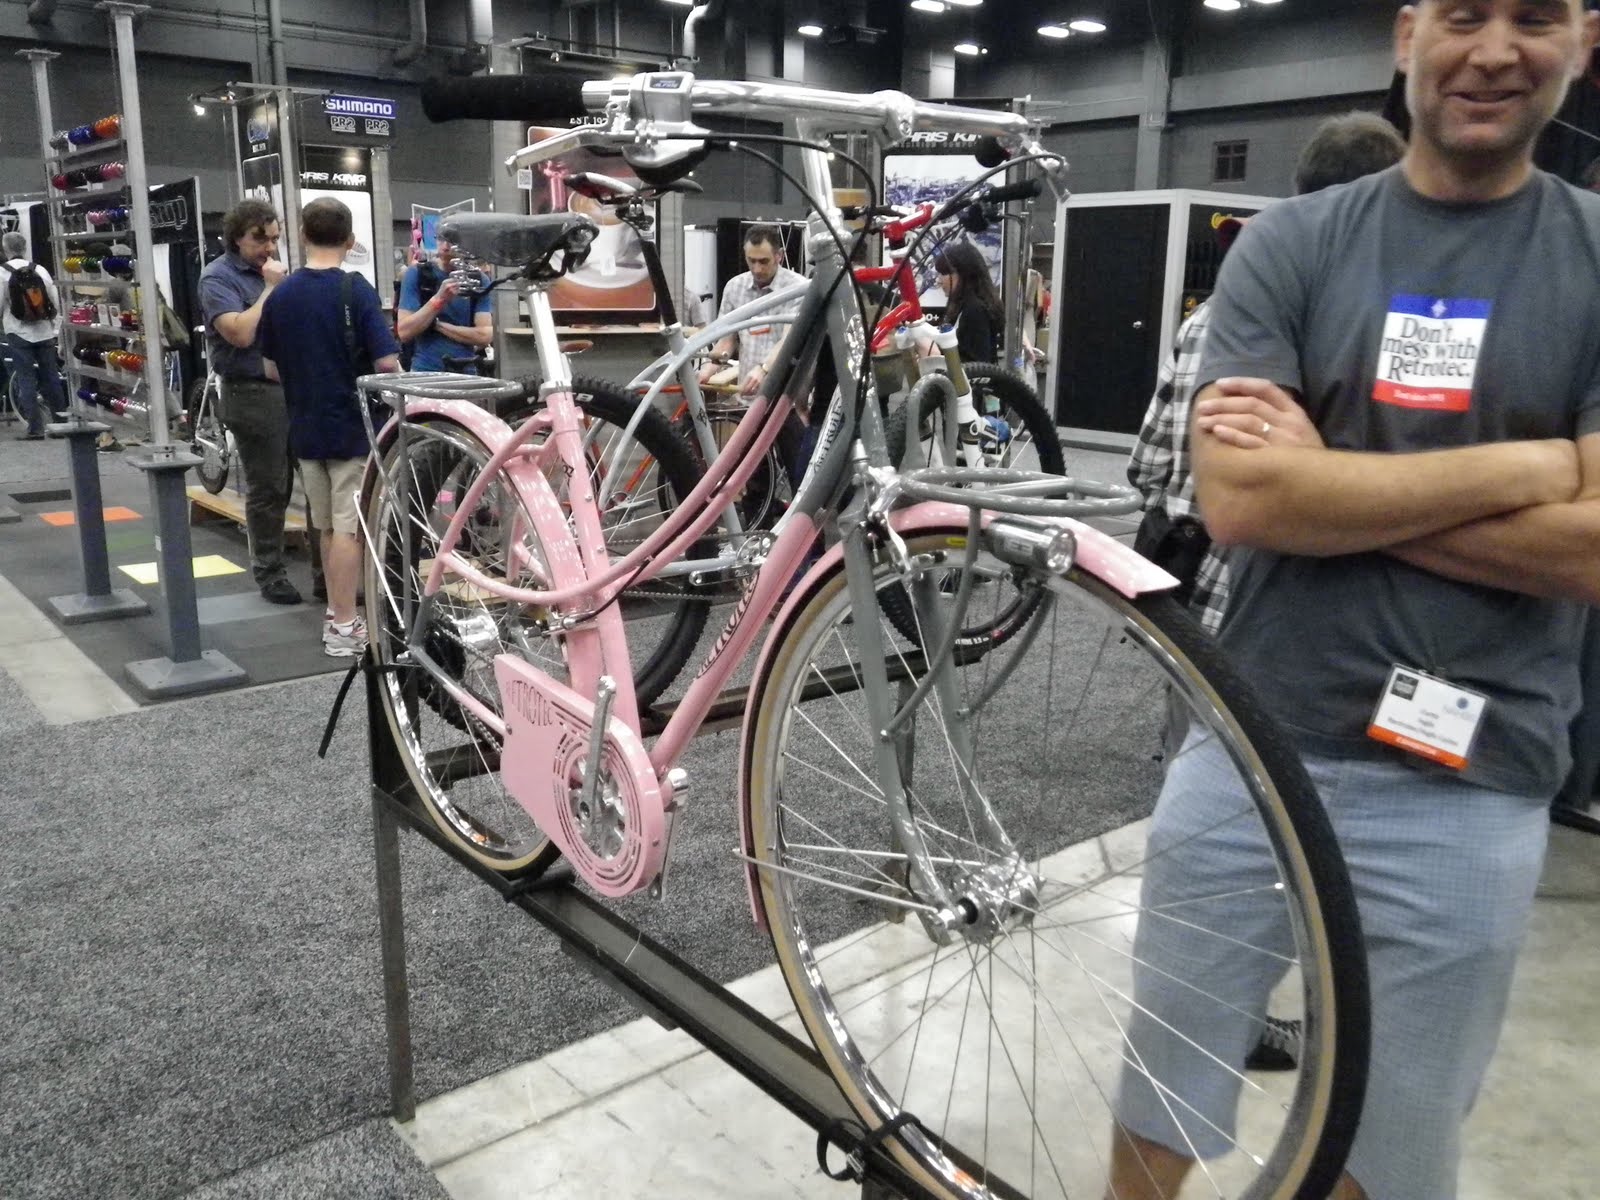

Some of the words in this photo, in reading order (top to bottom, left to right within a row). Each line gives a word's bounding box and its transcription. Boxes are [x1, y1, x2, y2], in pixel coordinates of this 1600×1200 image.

[326, 99, 392, 115] SHIMANO
[909, 131, 948, 142] HRIS
[299, 171, 329, 181] HRIS
[332, 173, 367, 183] KING
[1400, 316, 1453, 343] Don't
[1382, 337, 1429, 359] mess
[1435, 337, 1477, 360] with
